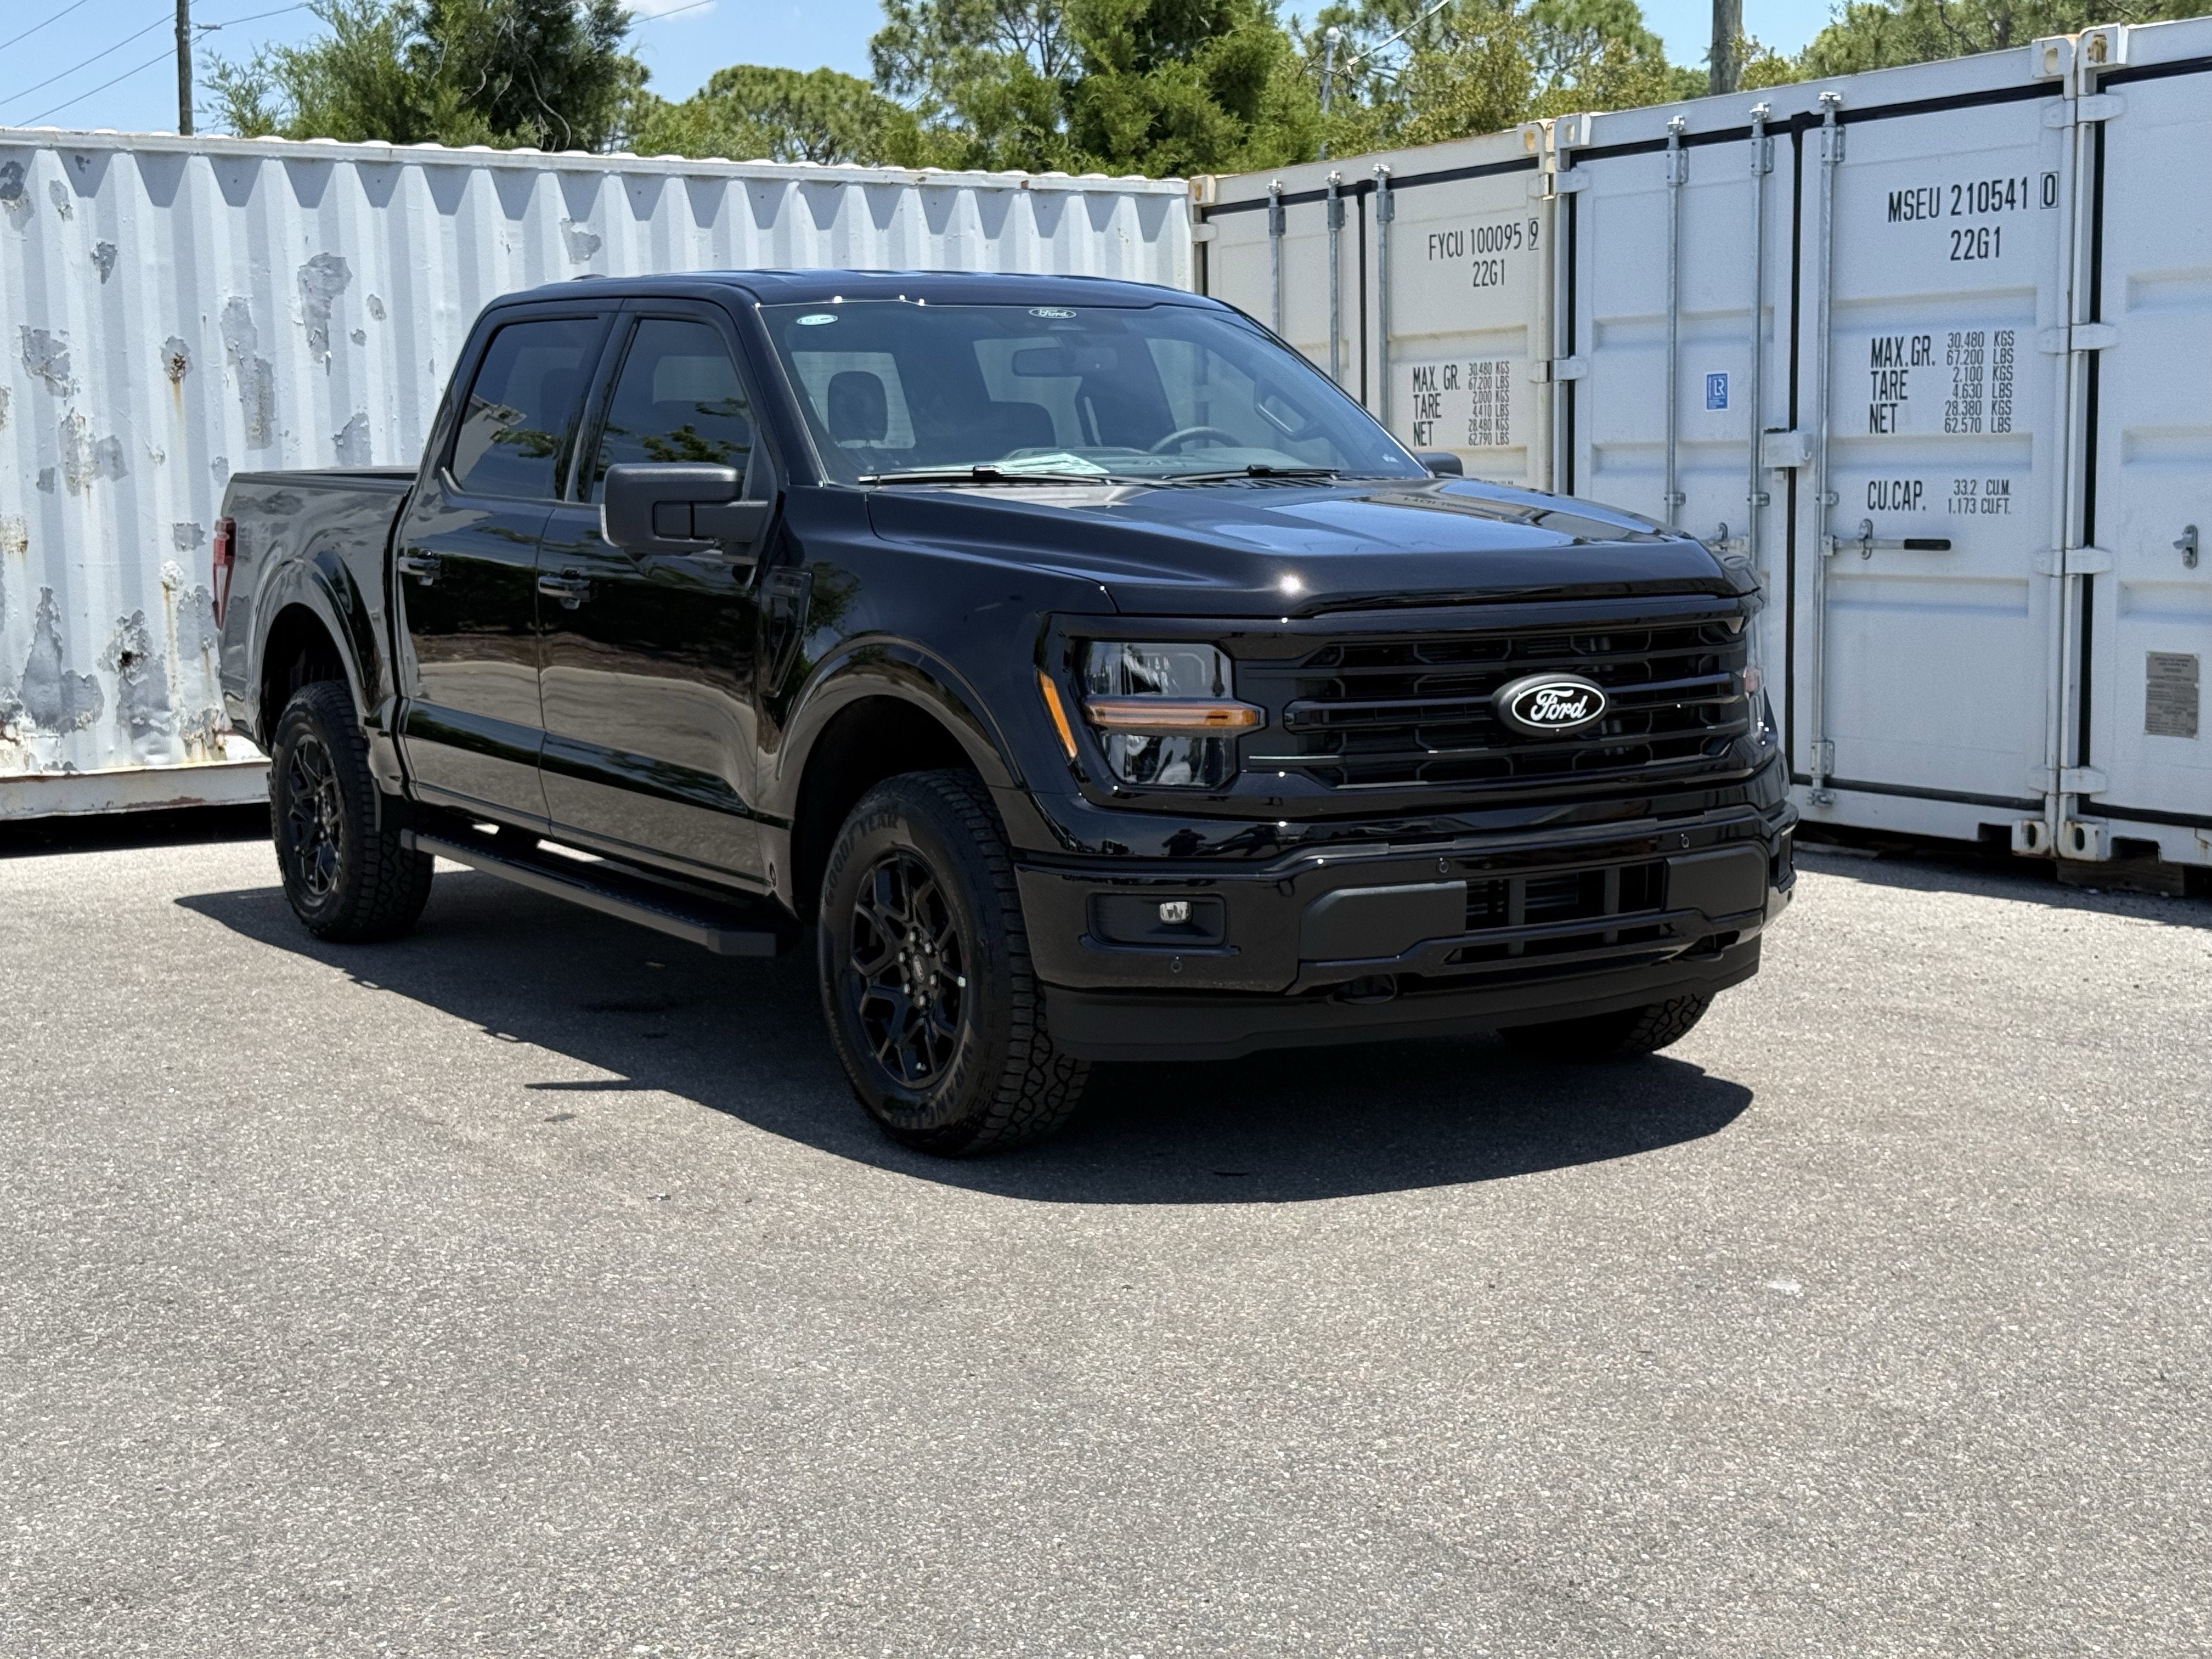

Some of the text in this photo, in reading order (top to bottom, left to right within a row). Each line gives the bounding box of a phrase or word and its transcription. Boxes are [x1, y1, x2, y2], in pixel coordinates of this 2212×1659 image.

[1888, 173, 2056, 222] MSEU 210541 0
[1429, 221, 1538, 261] FYCU 100095 9
[1950, 226, 2001, 261] 22G1
[1472, 258, 1505, 287] 22G1
[1947, 330, 2015, 348] 30.480 KGS
[1946, 348, 2014, 366] 67.200 LBS
[1496, 360, 1510, 375] KGS
[1953, 365, 2013, 383] 2.100 KGS
[1413, 364, 1460, 393] MAX. GR.
[1496, 375, 1510, 390] LBS
[1870, 370, 1909, 401] TARE
[1496, 389, 1510, 403] KGS
[1952, 382, 2013, 400] 4.630 LBS
[1413, 393, 1442, 420] TARE
[1495, 403, 1509, 417] LBS
[1945, 399, 2012, 417] 28.380 KGS
[1496, 417, 1510, 432] KGS
[1869, 403, 1899, 434] NET
[1944, 416, 2011, 433] 62.570 LBS
[1413, 421, 1434, 447] NET
[1496, 431, 1509, 445] LBS
[1867, 480, 1926, 511] CU.CAP.
[1954, 479, 1977, 496] 33.2
[1948, 497, 1976, 514] 1.173
[1531, 689, 1588, 721] Ford
